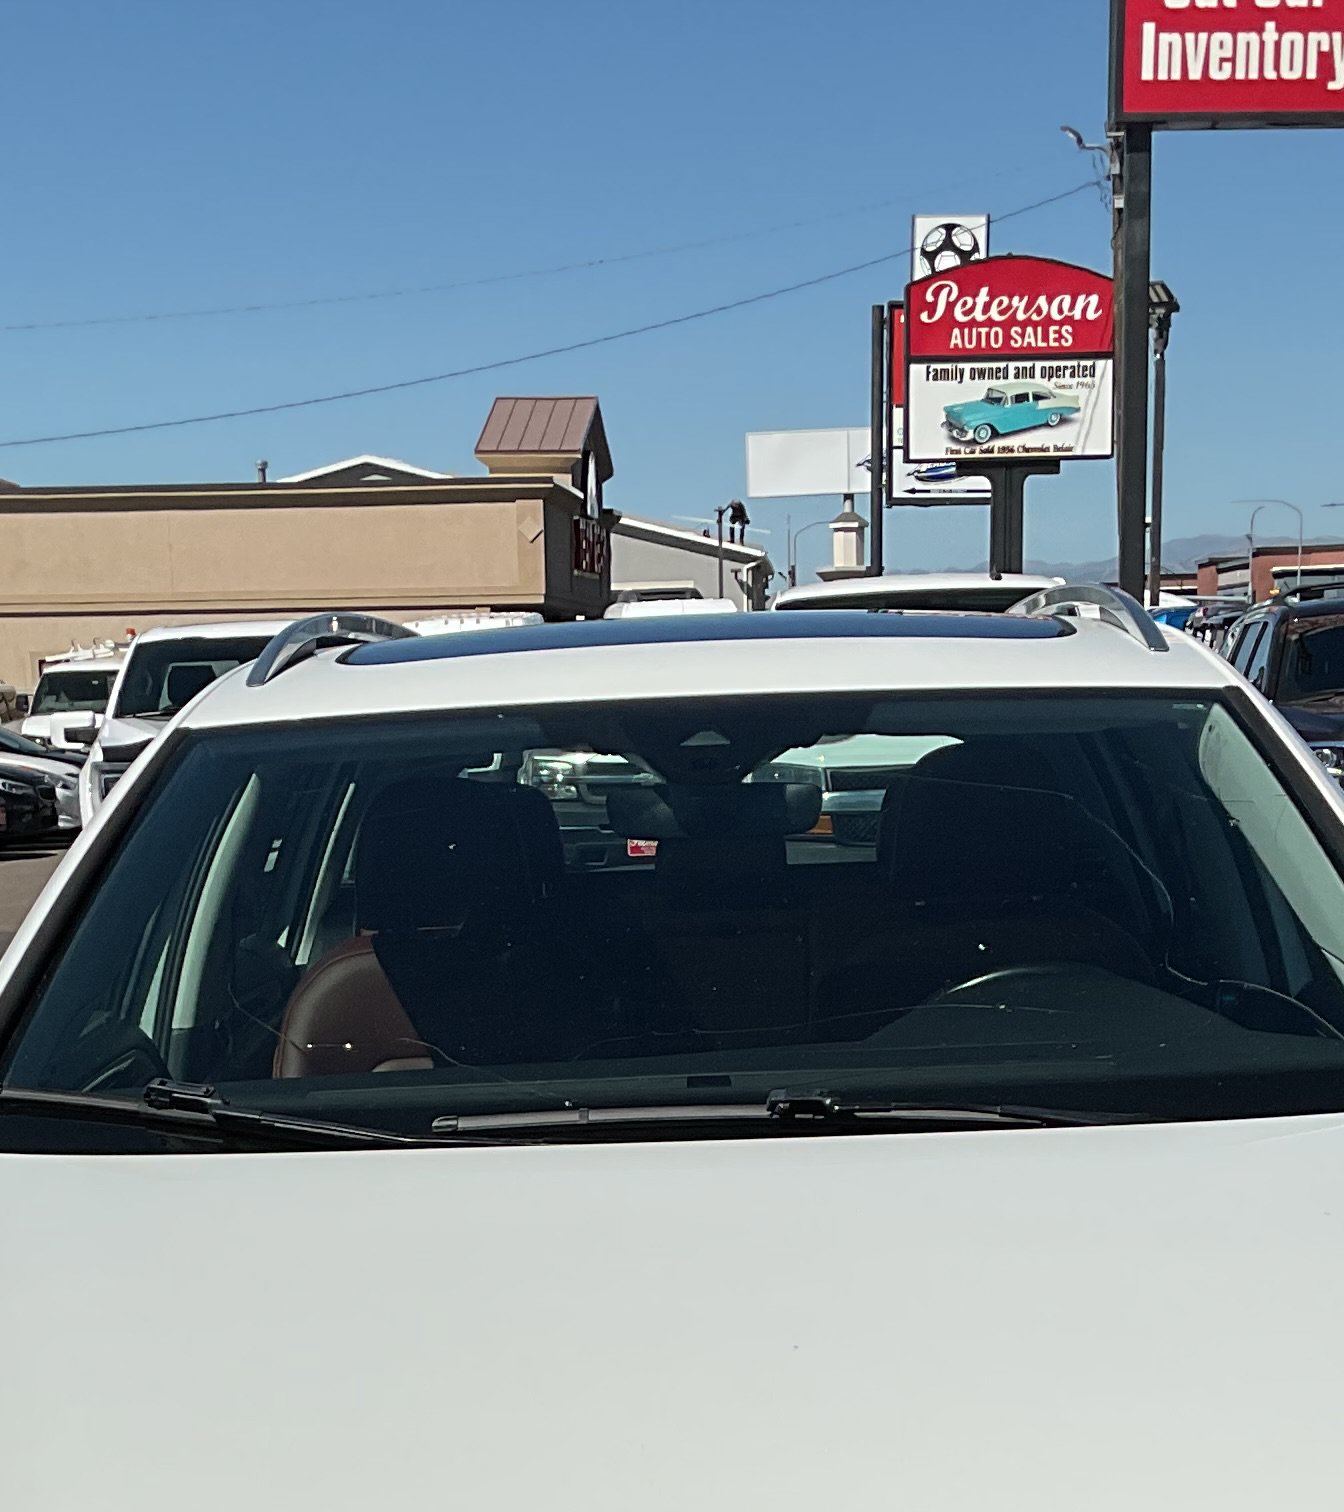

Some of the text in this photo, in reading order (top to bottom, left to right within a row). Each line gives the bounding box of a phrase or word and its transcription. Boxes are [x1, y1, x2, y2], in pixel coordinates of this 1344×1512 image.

[920, 280, 1103, 323] Peterson
[950, 325, 1073, 349] AUTO SALES
[925, 361, 1096, 384] Family owned and operated
